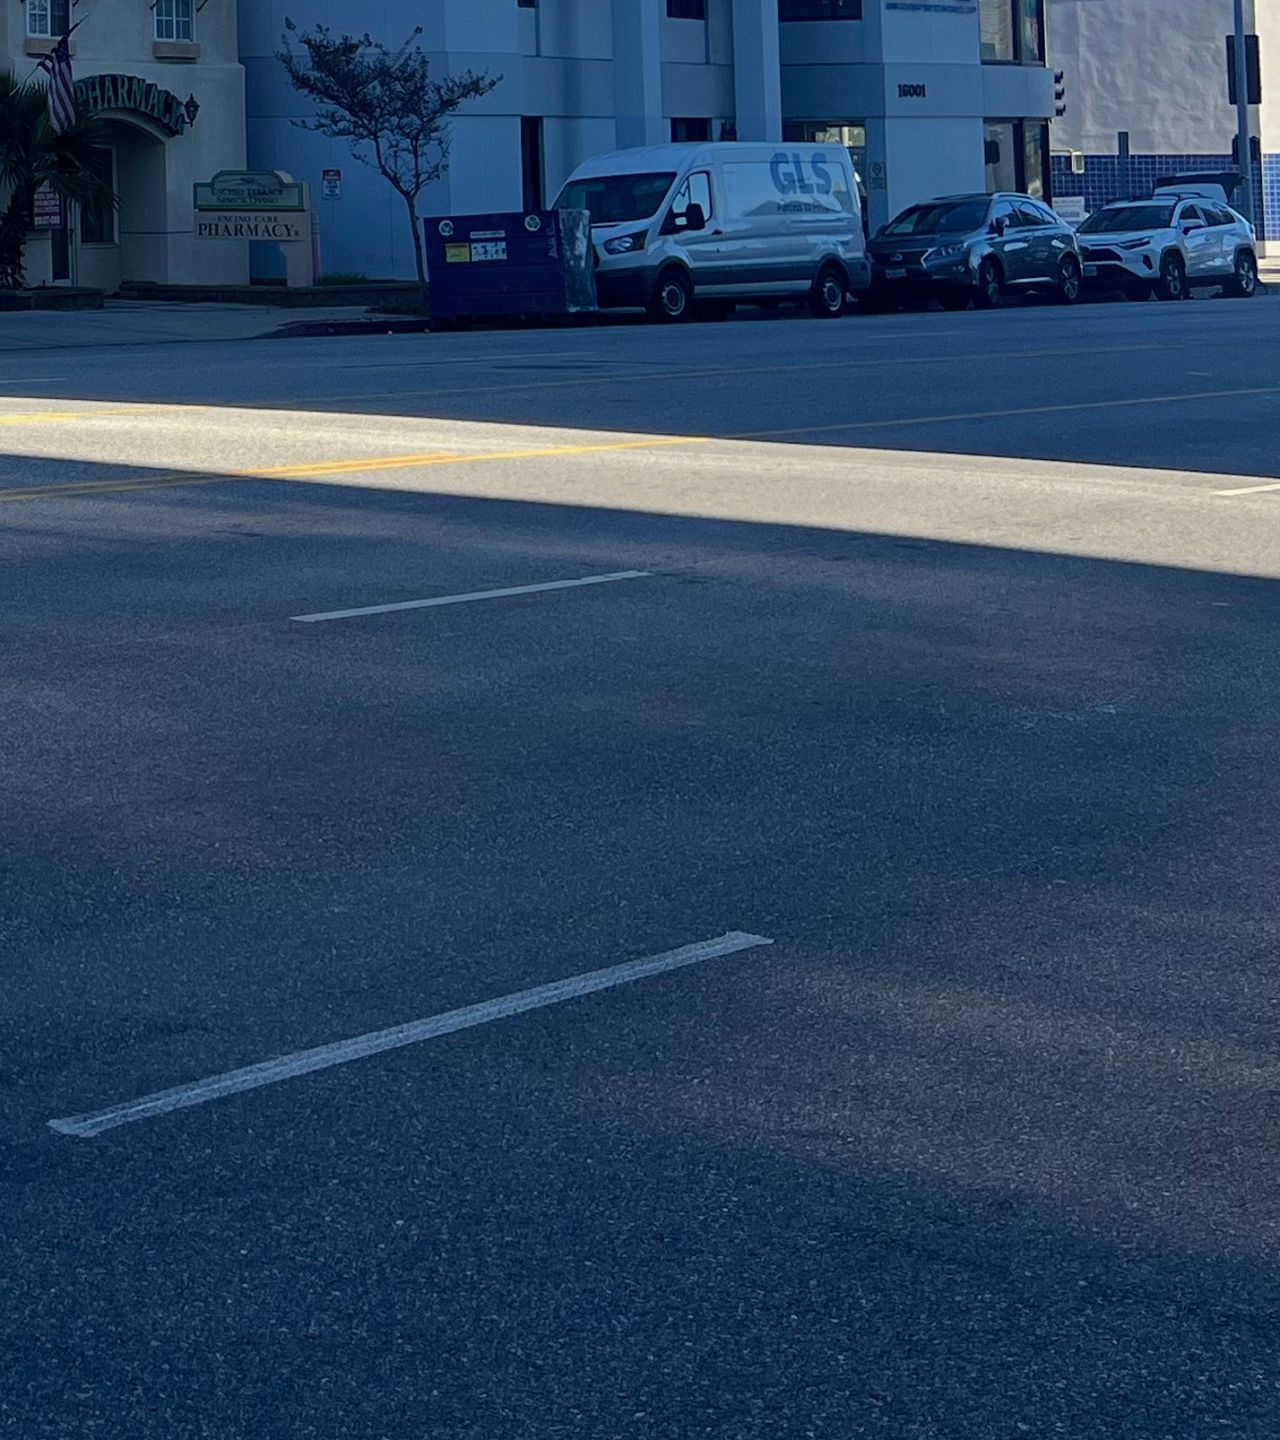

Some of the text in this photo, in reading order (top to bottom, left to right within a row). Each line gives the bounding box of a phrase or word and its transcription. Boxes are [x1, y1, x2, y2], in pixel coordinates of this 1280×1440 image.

[897, 83, 927, 98] 16001
[74, 74, 185, 137] PHARMACY
[770, 152, 832, 195] GLS
[217, 215, 280, 223] ENCINO CARE
[198, 223, 294, 237] PHARMACY
